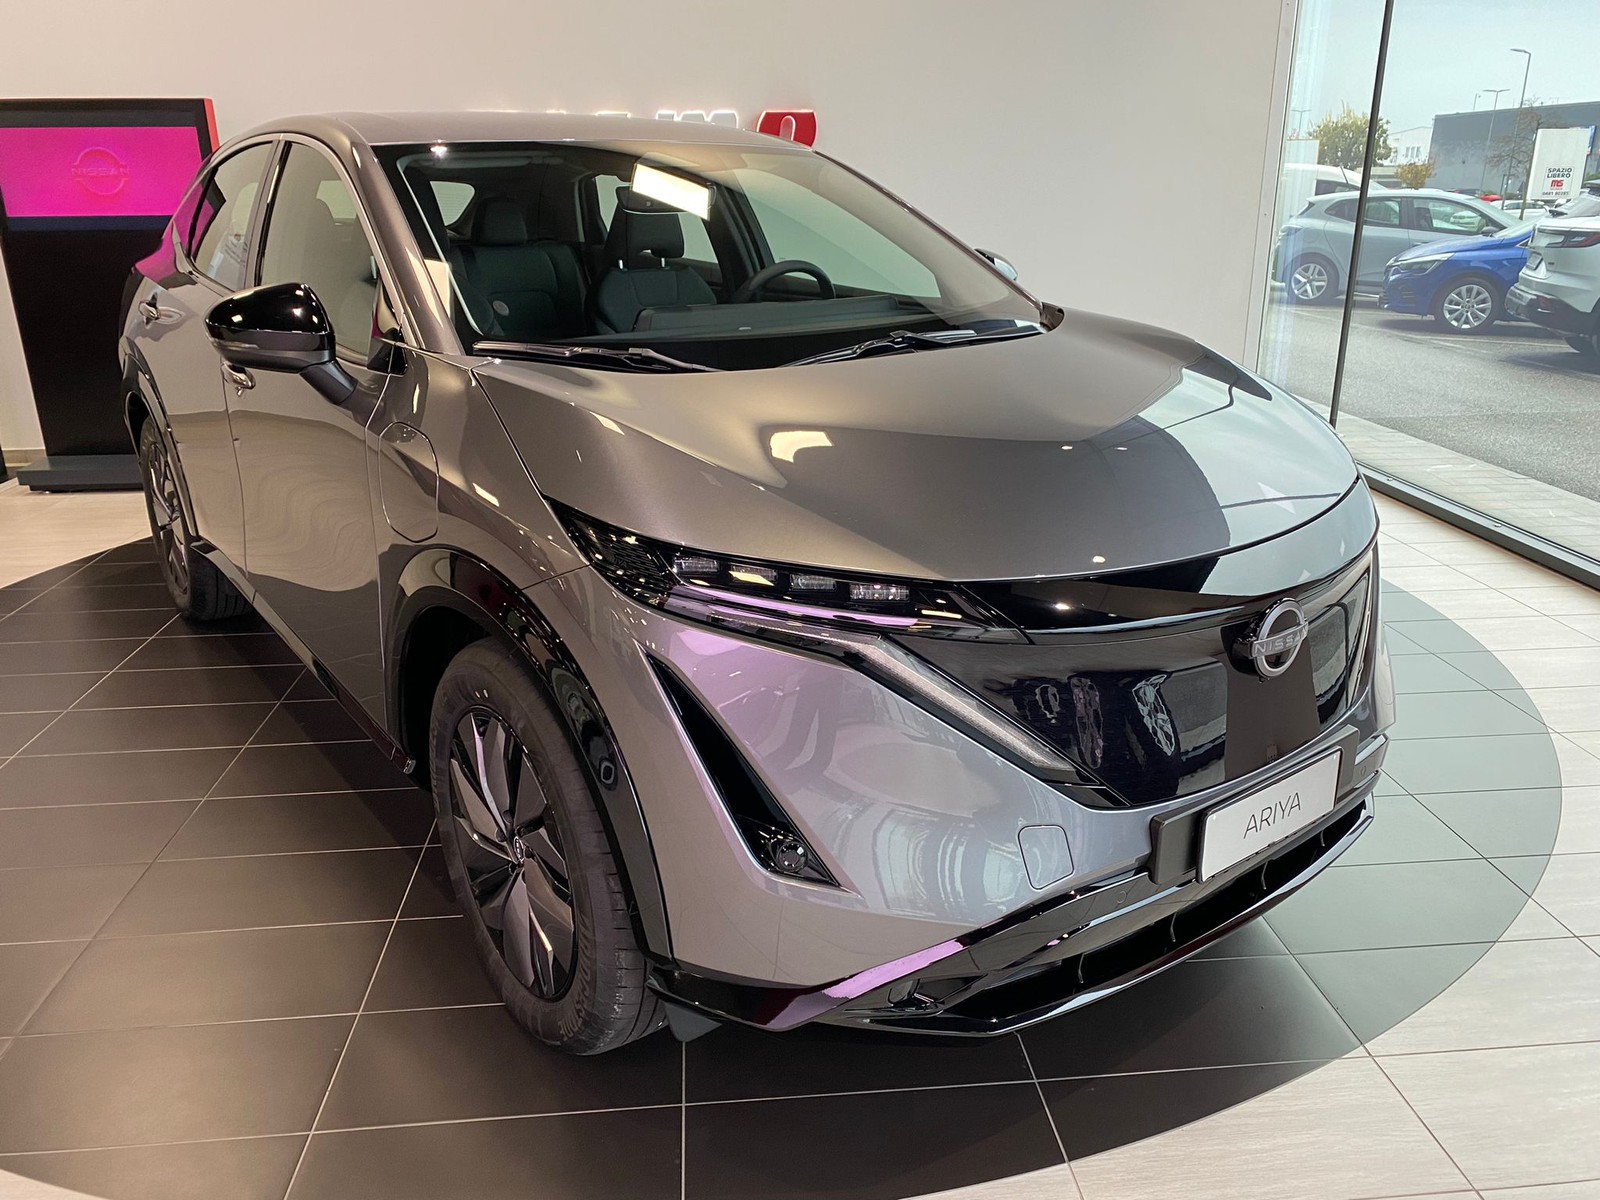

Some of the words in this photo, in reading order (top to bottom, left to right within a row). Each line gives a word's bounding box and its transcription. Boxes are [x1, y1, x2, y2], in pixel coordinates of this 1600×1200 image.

[71, 168, 130, 176] NISSAN
[1253, 624, 1308, 655] NISSAN
[1243, 792, 1301, 839] ARIYA
